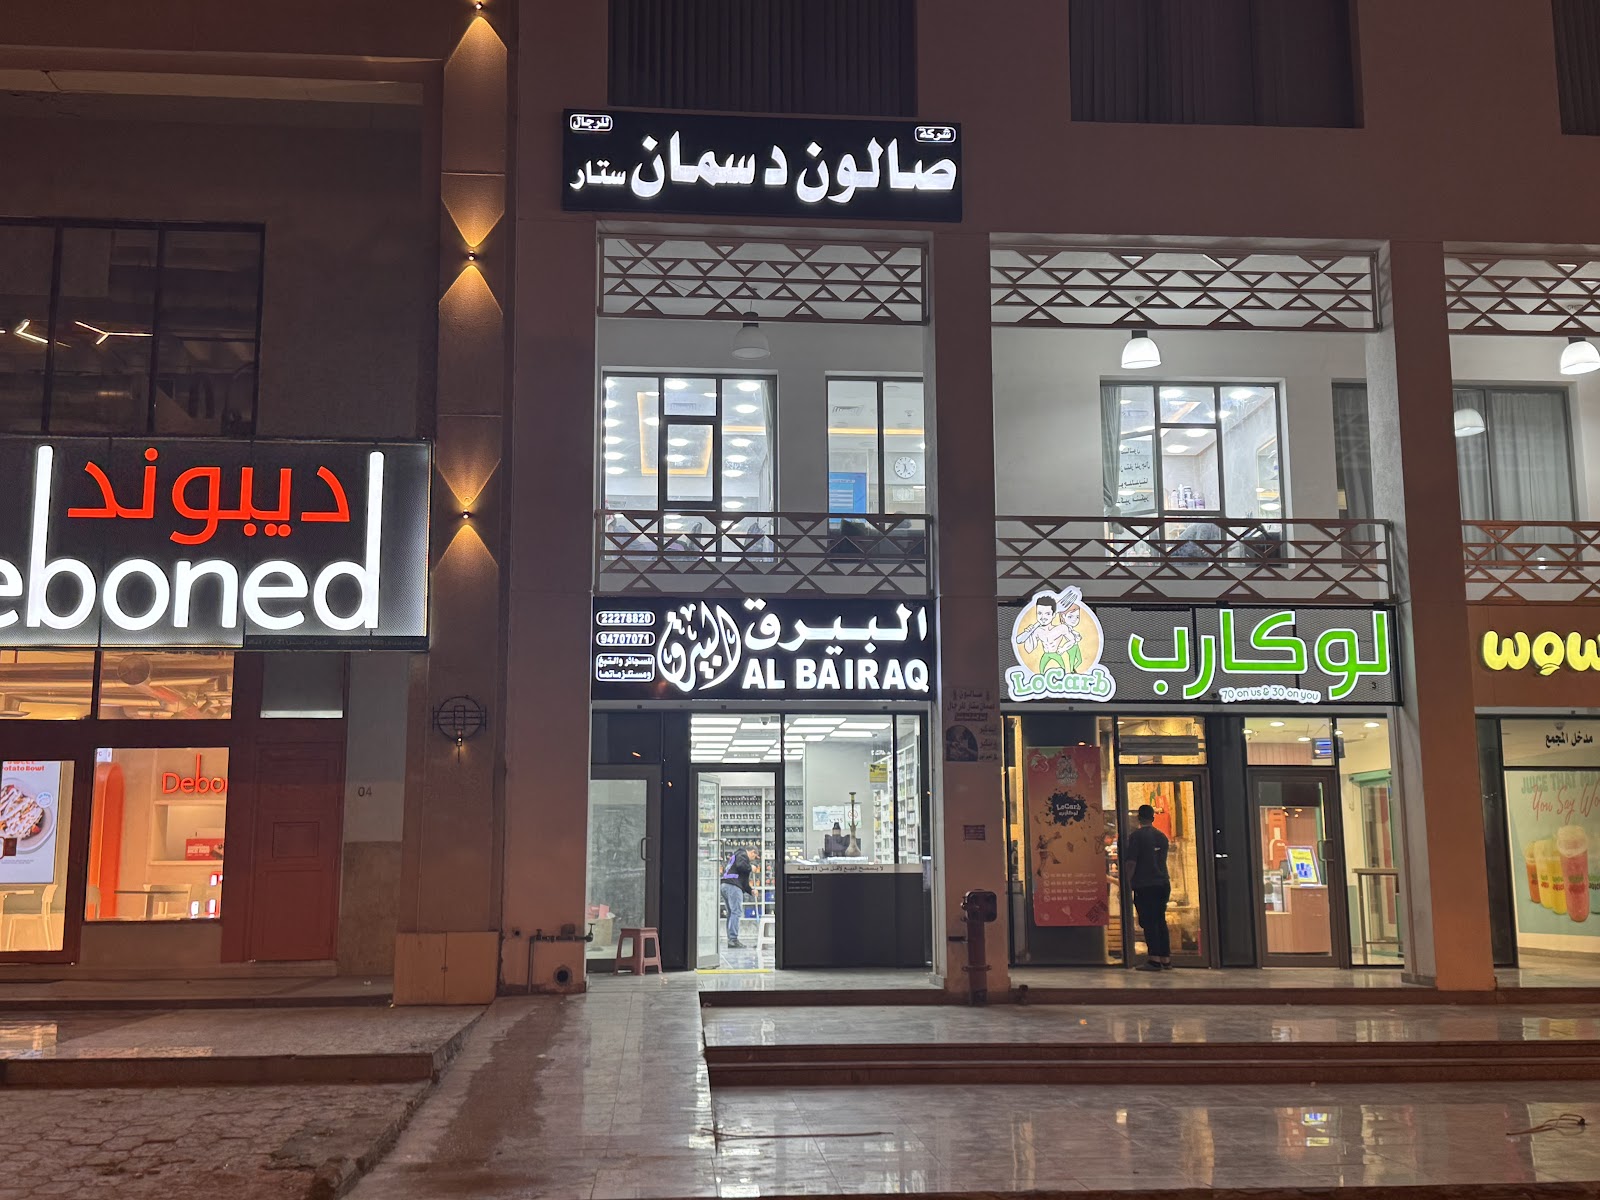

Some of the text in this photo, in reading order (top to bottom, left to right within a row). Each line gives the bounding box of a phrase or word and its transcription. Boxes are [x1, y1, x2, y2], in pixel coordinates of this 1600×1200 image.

[572, 114, 611, 130] للرجال
[917, 127, 953, 141] شركة
[569, 159, 627, 189] ستار
[796, 137, 957, 203] صالون
[67, 447, 351, 545] ديبوند
[600, 613, 651, 624] 22278820
[744, 598, 928, 655] البيرق
[600, 633, 650, 644] 94707071
[1128, 609, 1391, 700] لوكارب
[742, 658, 930, 693] AL BAIRAQ
[1011, 668, 1111, 697] LoCarb
[1222, 687, 1319, 701] 70 on us & 30 on you
[1545, 731, 1594, 748] مدخل المجمع
[162, 753, 228, 794] Debo
[1521, 774, 1548, 794] JUICE
[357, 786, 373, 798] 04
[1533, 784, 1553, 822] You
[1557, 785, 1576, 826] Say
